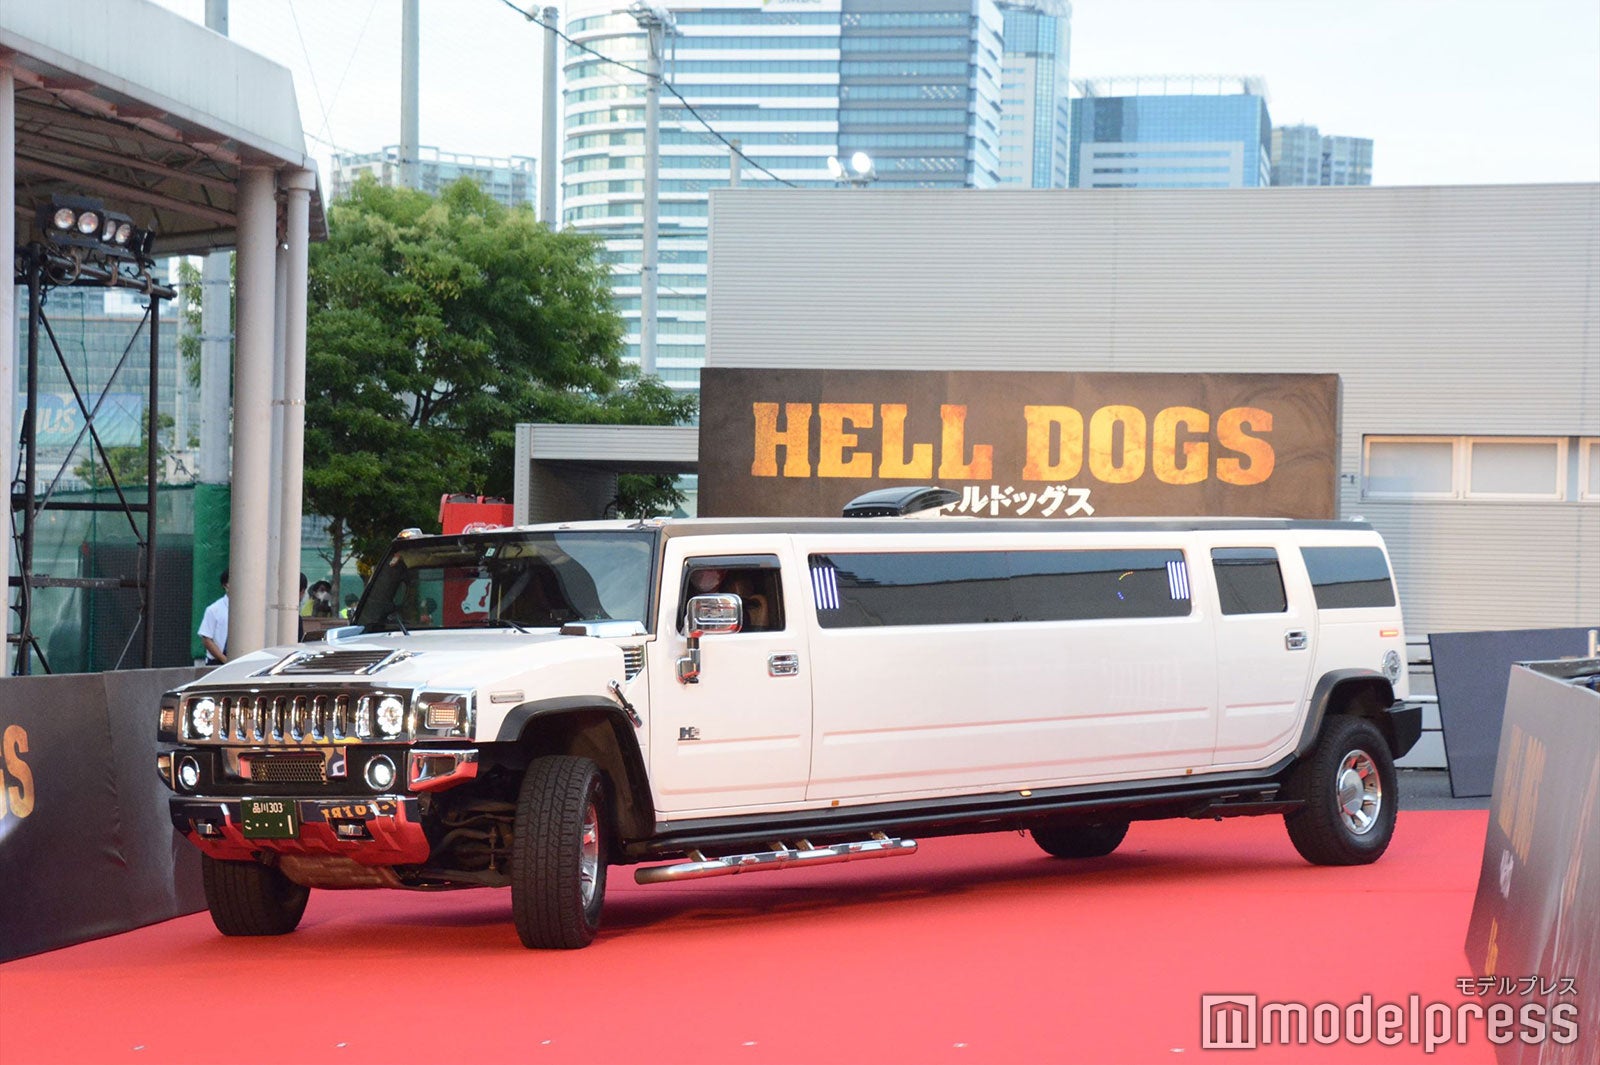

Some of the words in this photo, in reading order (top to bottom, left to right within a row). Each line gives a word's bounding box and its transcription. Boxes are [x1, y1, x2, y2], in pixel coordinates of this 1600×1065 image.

[751, 402, 993, 480] HELL
[1022, 404, 1276, 486] DOGS
[940, 485, 1096, 517] ルドッグス
